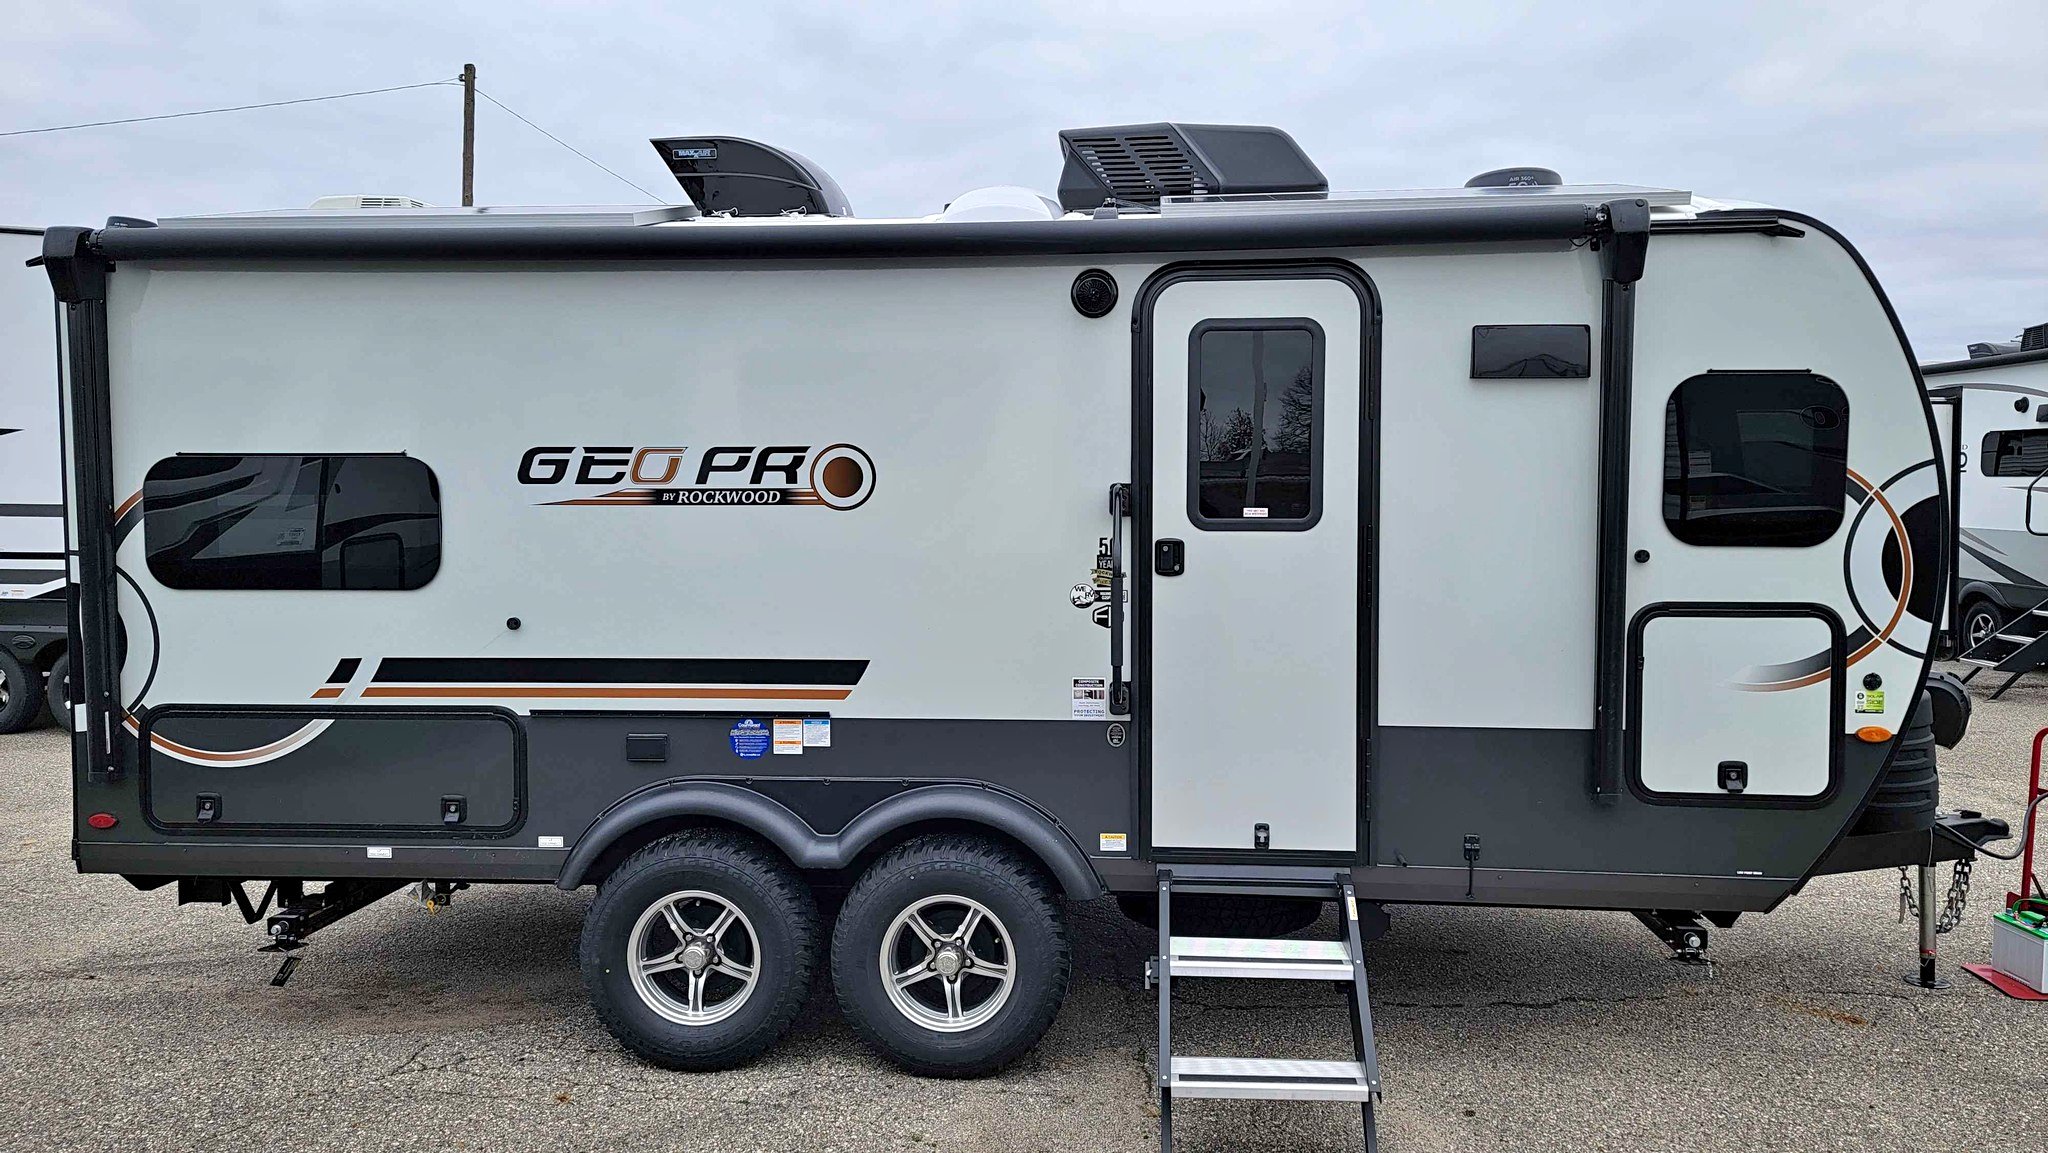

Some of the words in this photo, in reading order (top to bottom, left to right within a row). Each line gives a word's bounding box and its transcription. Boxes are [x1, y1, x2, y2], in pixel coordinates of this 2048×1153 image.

[517, 446, 688, 485] GEO
[662, 493, 676, 501] BY
[677, 490, 781, 504] ROCKWOOD
